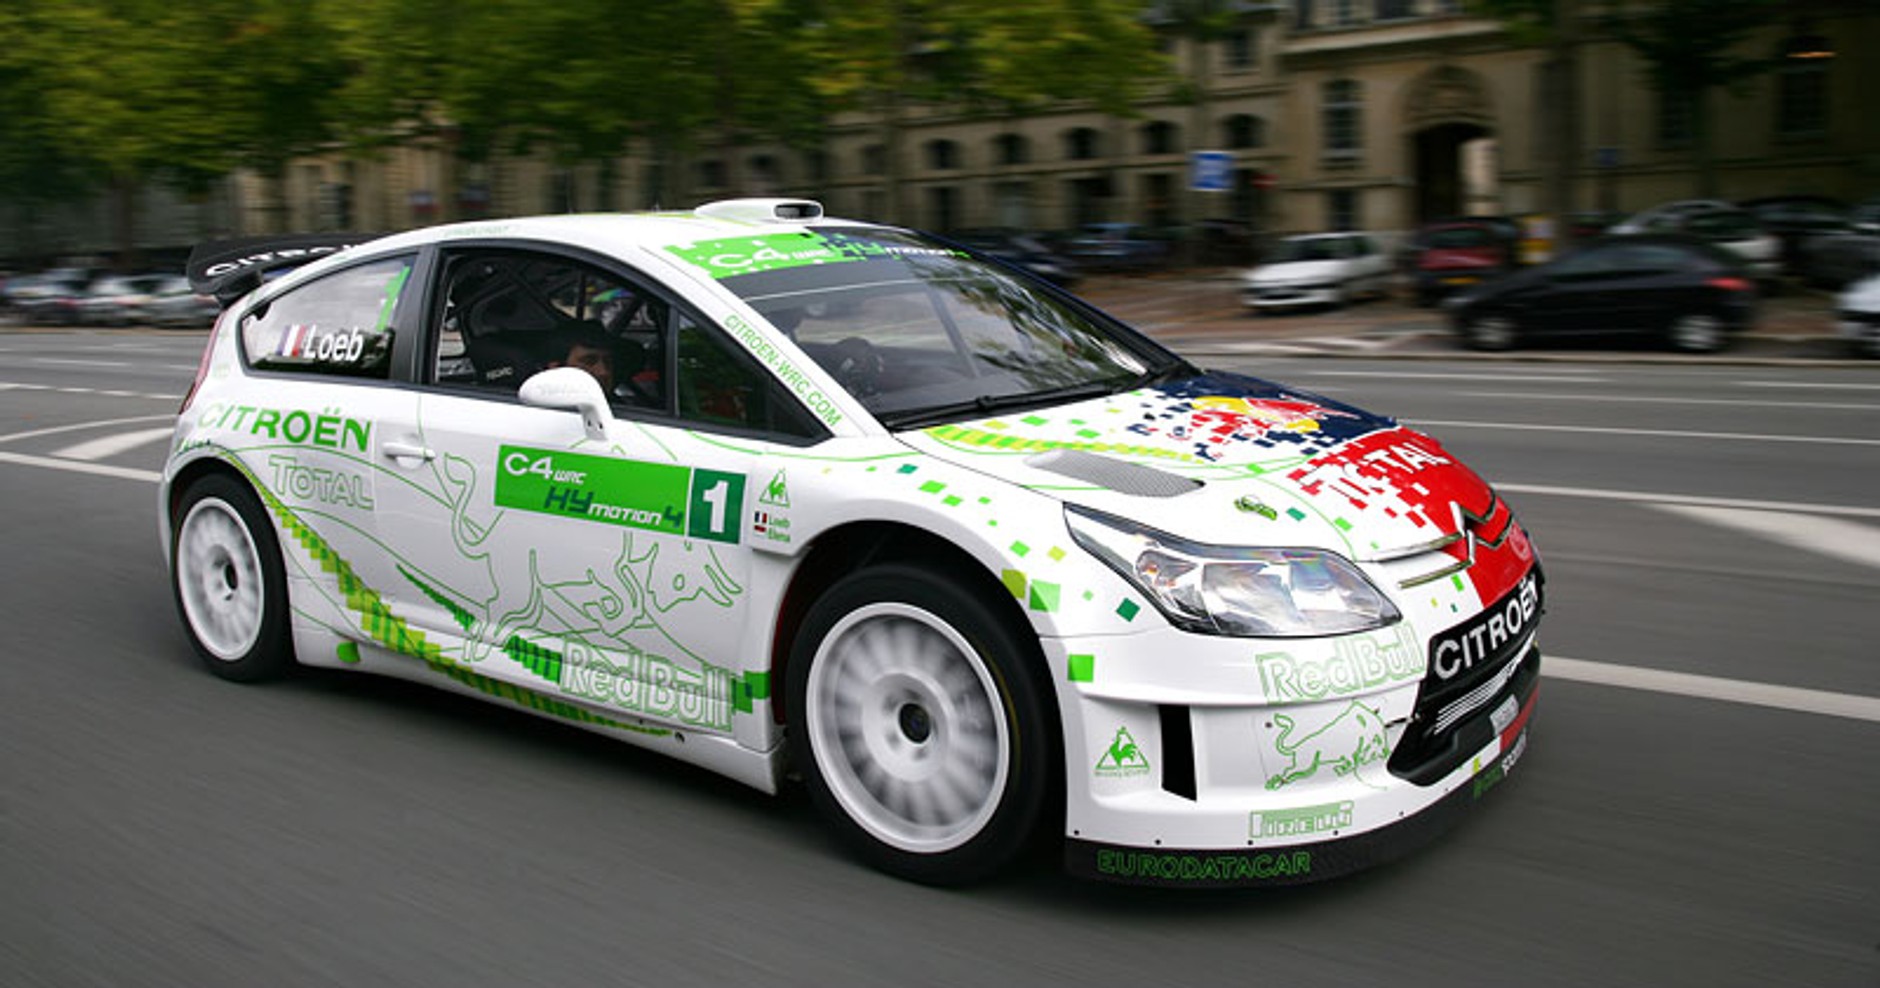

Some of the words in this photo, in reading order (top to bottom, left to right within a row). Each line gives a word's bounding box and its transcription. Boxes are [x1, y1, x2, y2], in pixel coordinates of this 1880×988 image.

[302, 327, 364, 362] Loeb
[197, 402, 373, 451] CITROËN
[267, 454, 375, 511] TOTAL
[504, 452, 553, 480] C4
[702, 479, 730, 534] 1
[1434, 573, 1539, 680] CITROËN
[1097, 850, 1312, 879] EURODATACAR
